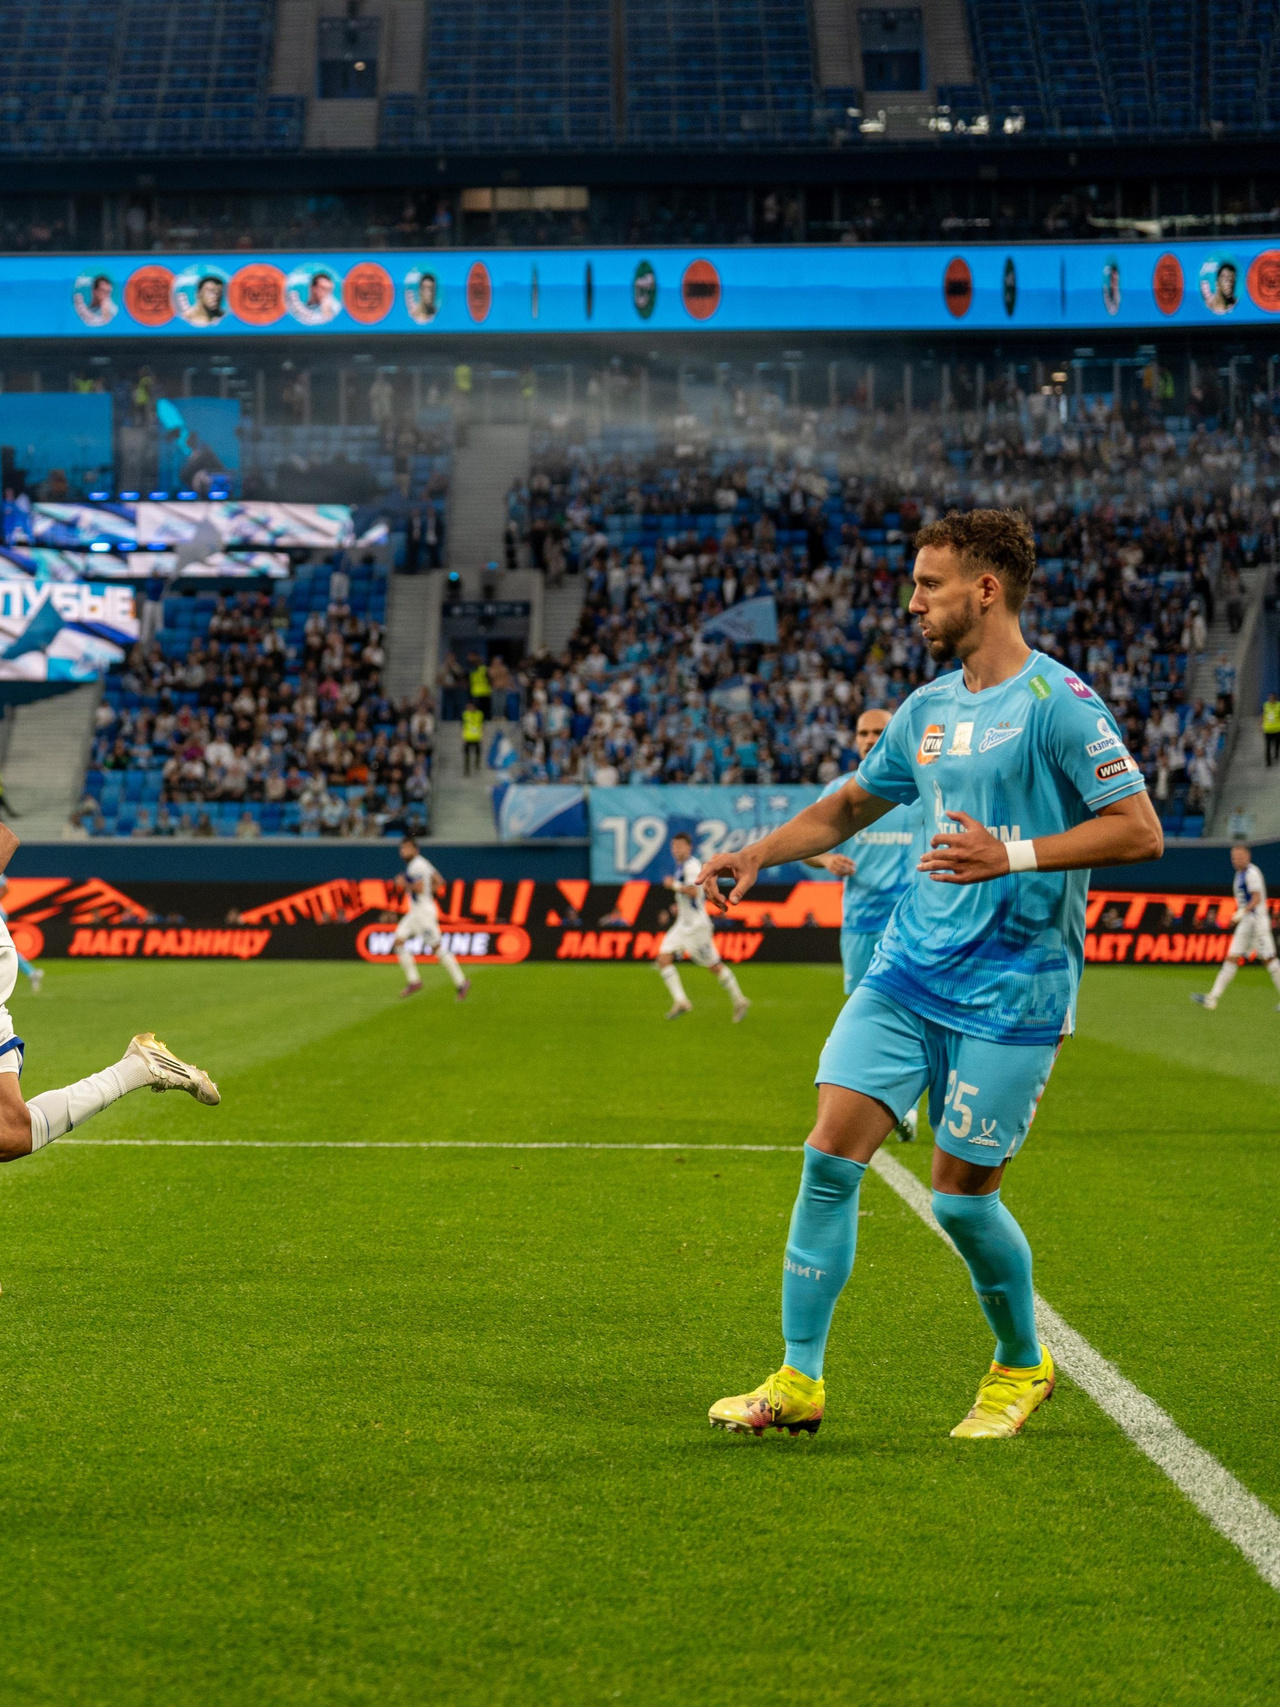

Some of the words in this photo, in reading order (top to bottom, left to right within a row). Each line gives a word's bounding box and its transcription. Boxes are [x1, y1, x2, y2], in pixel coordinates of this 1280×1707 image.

[1088, 738, 1116, 754] ГАЗПРО
[1100, 759, 1128, 778] WINL
[598, 815, 668, 874] 19
[142, 928, 271, 960] РАЗНИЦУ
[1084, 933, 1134, 962] АЕТ
